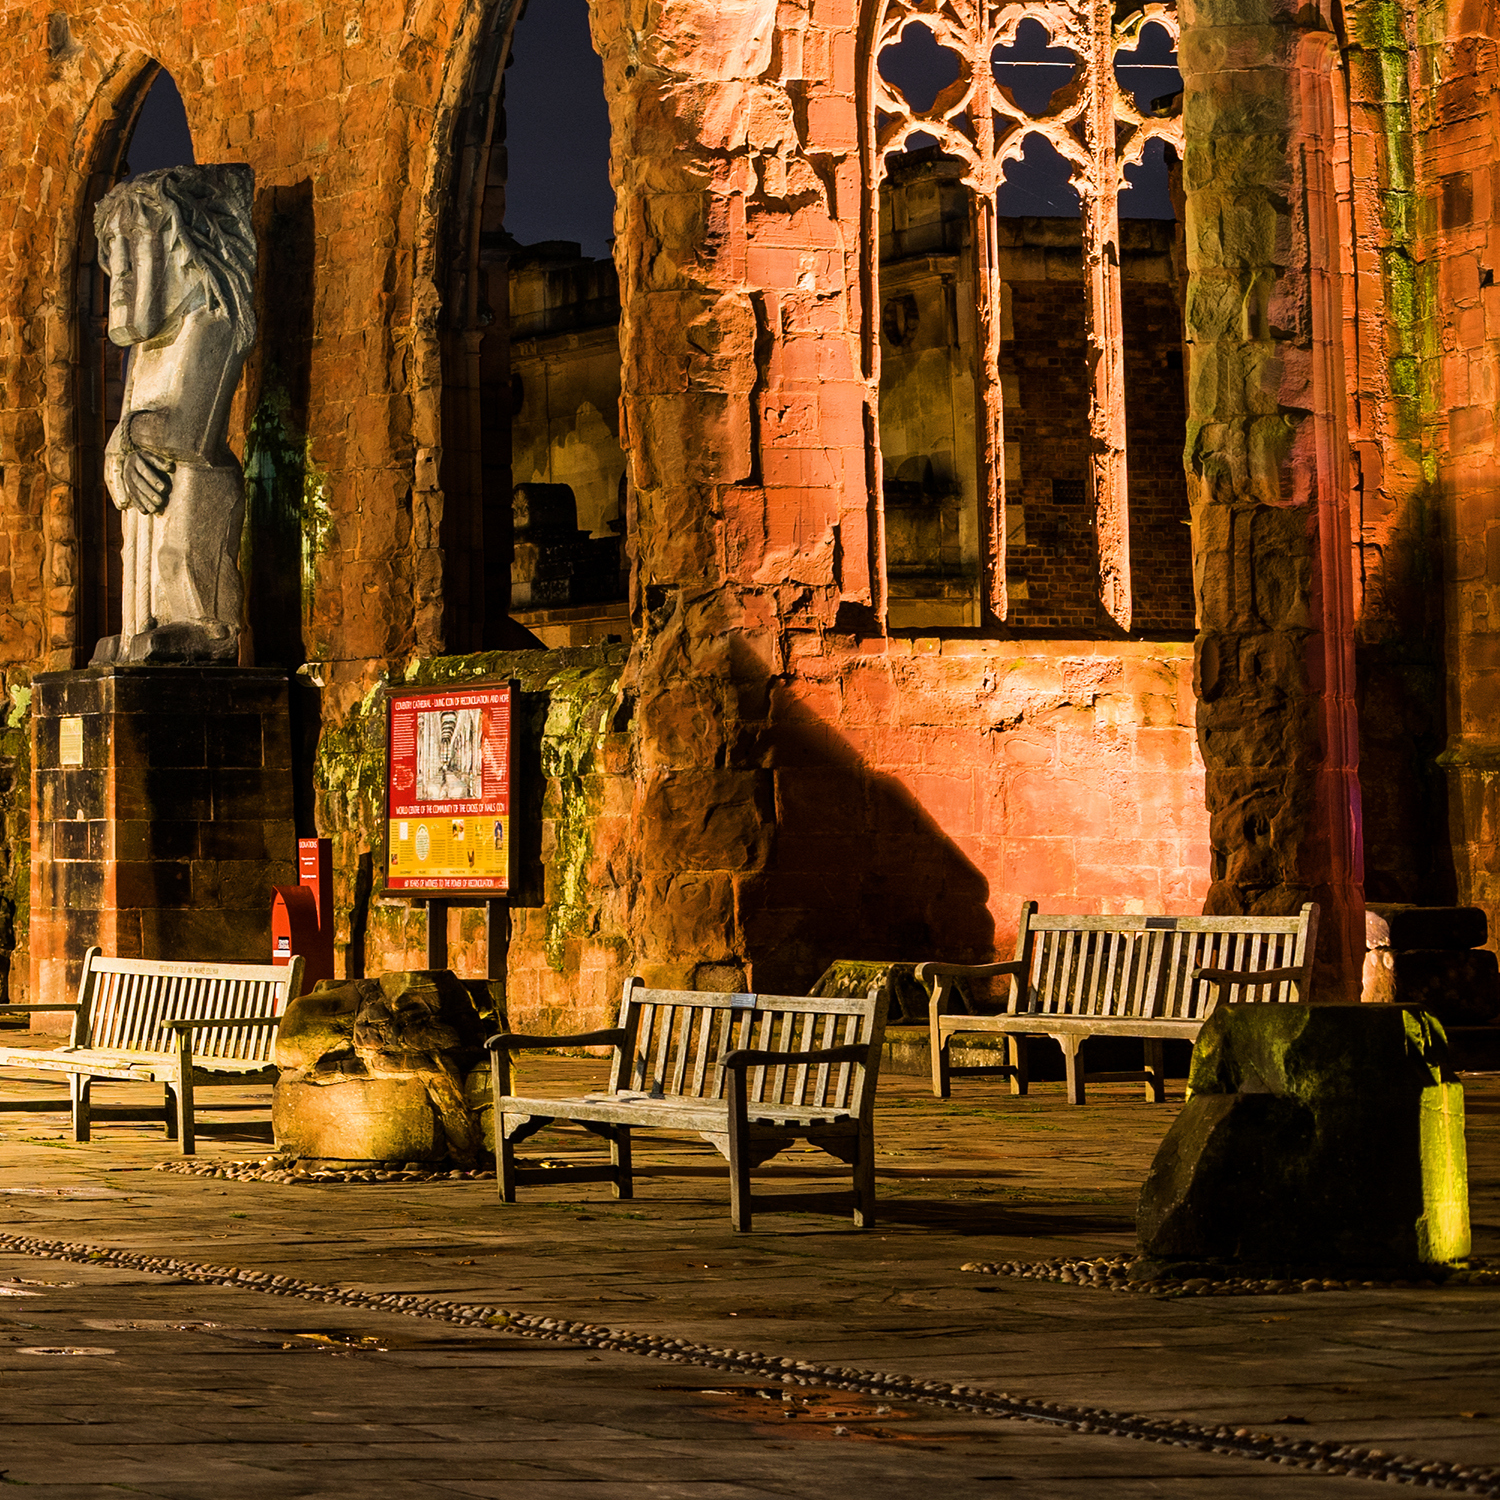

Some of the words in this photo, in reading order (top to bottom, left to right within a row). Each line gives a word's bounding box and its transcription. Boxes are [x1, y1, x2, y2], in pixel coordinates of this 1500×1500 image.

[490, 694, 499, 703] AND
[499, 694, 509, 703] HOPE
[420, 805, 426, 814] OF
[453, 804, 459, 813] OF
[466, 803, 479, 813] CROSS
[479, 803, 484, 812] OF
[484, 802, 496, 812] NAILS
[468, 878, 494, 887] RECONCILIATION
